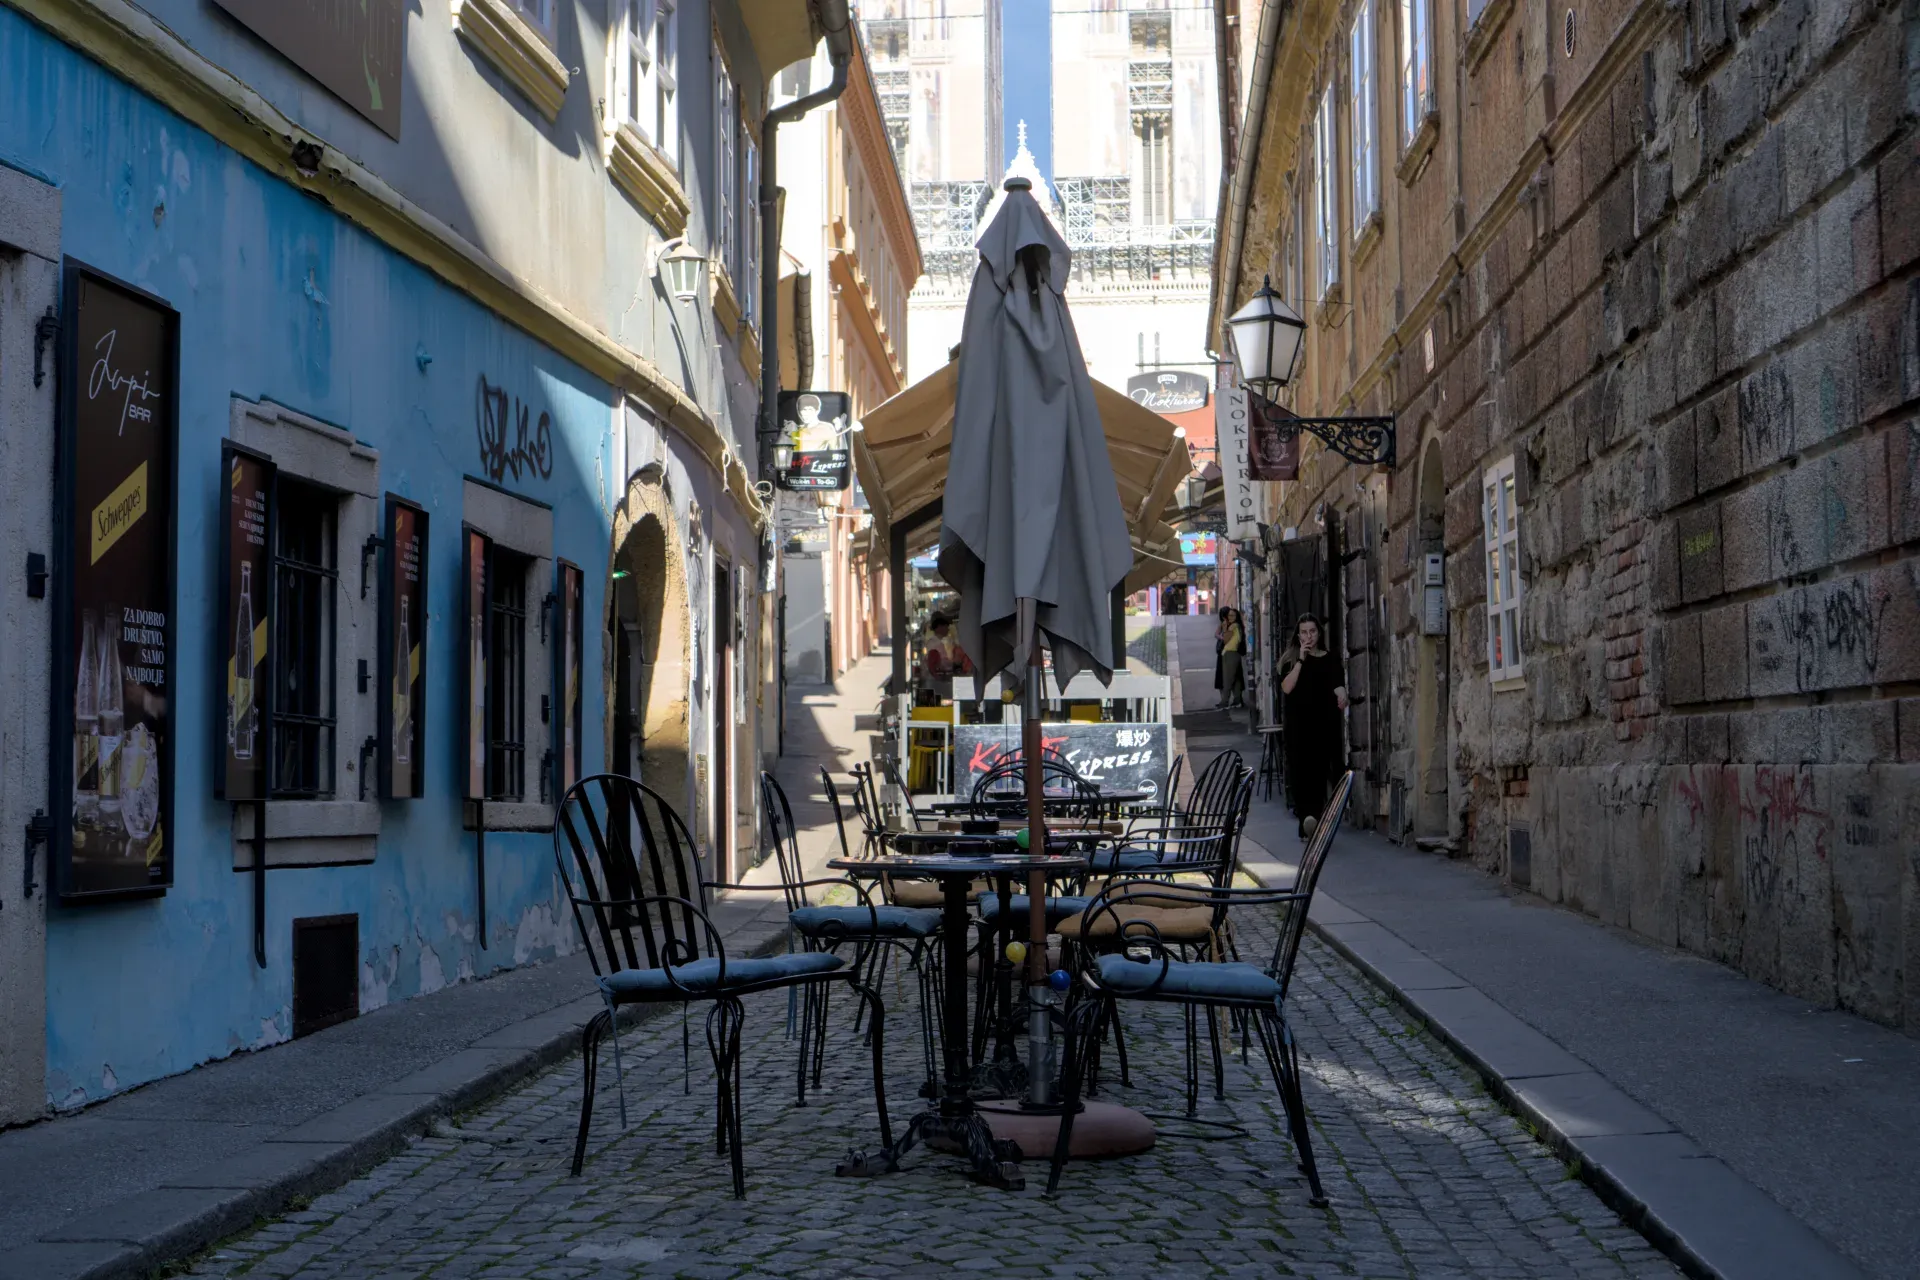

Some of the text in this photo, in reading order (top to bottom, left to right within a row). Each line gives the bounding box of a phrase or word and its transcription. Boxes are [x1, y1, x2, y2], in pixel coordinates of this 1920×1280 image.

[128, 403, 151, 424] BAR
[1229, 394, 1253, 508] NOKTURNO
[97, 485, 142, 542] Schweppes
[123, 607, 165, 628] ZA DOBRO
[123, 625, 165, 649] DRUŠTVO,
[141, 648, 165, 666] SAMO
[125, 665, 165, 686] NAJBOLJE
[1116, 729, 1151, 748] 爆炒
